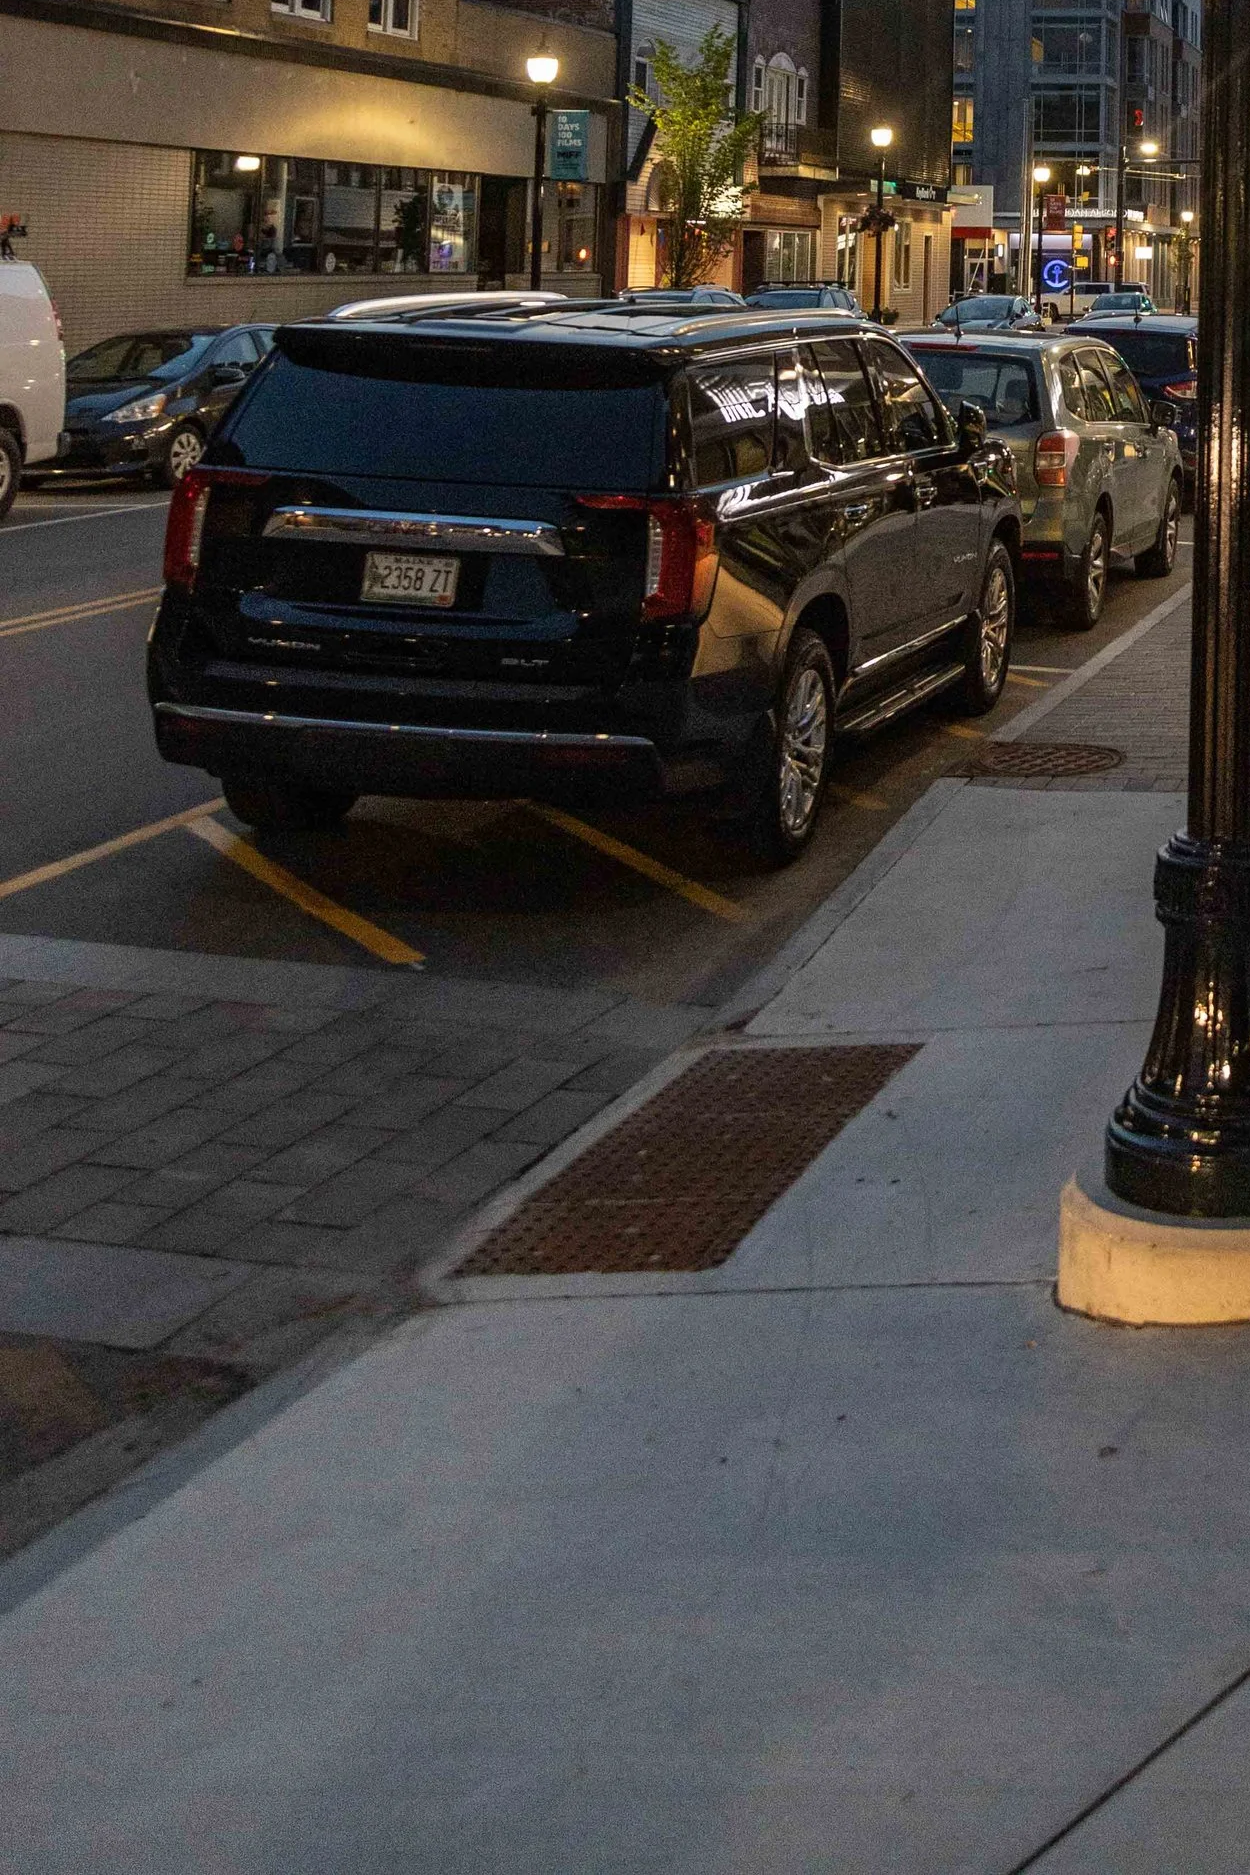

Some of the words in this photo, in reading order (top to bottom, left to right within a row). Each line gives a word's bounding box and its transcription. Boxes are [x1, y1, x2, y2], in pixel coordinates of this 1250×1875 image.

[557, 139, 582, 147] FILMS
[394, 556, 434, 565] MAINE
[380, 566, 425, 591] 2358
[429, 569, 452, 593] ZT
